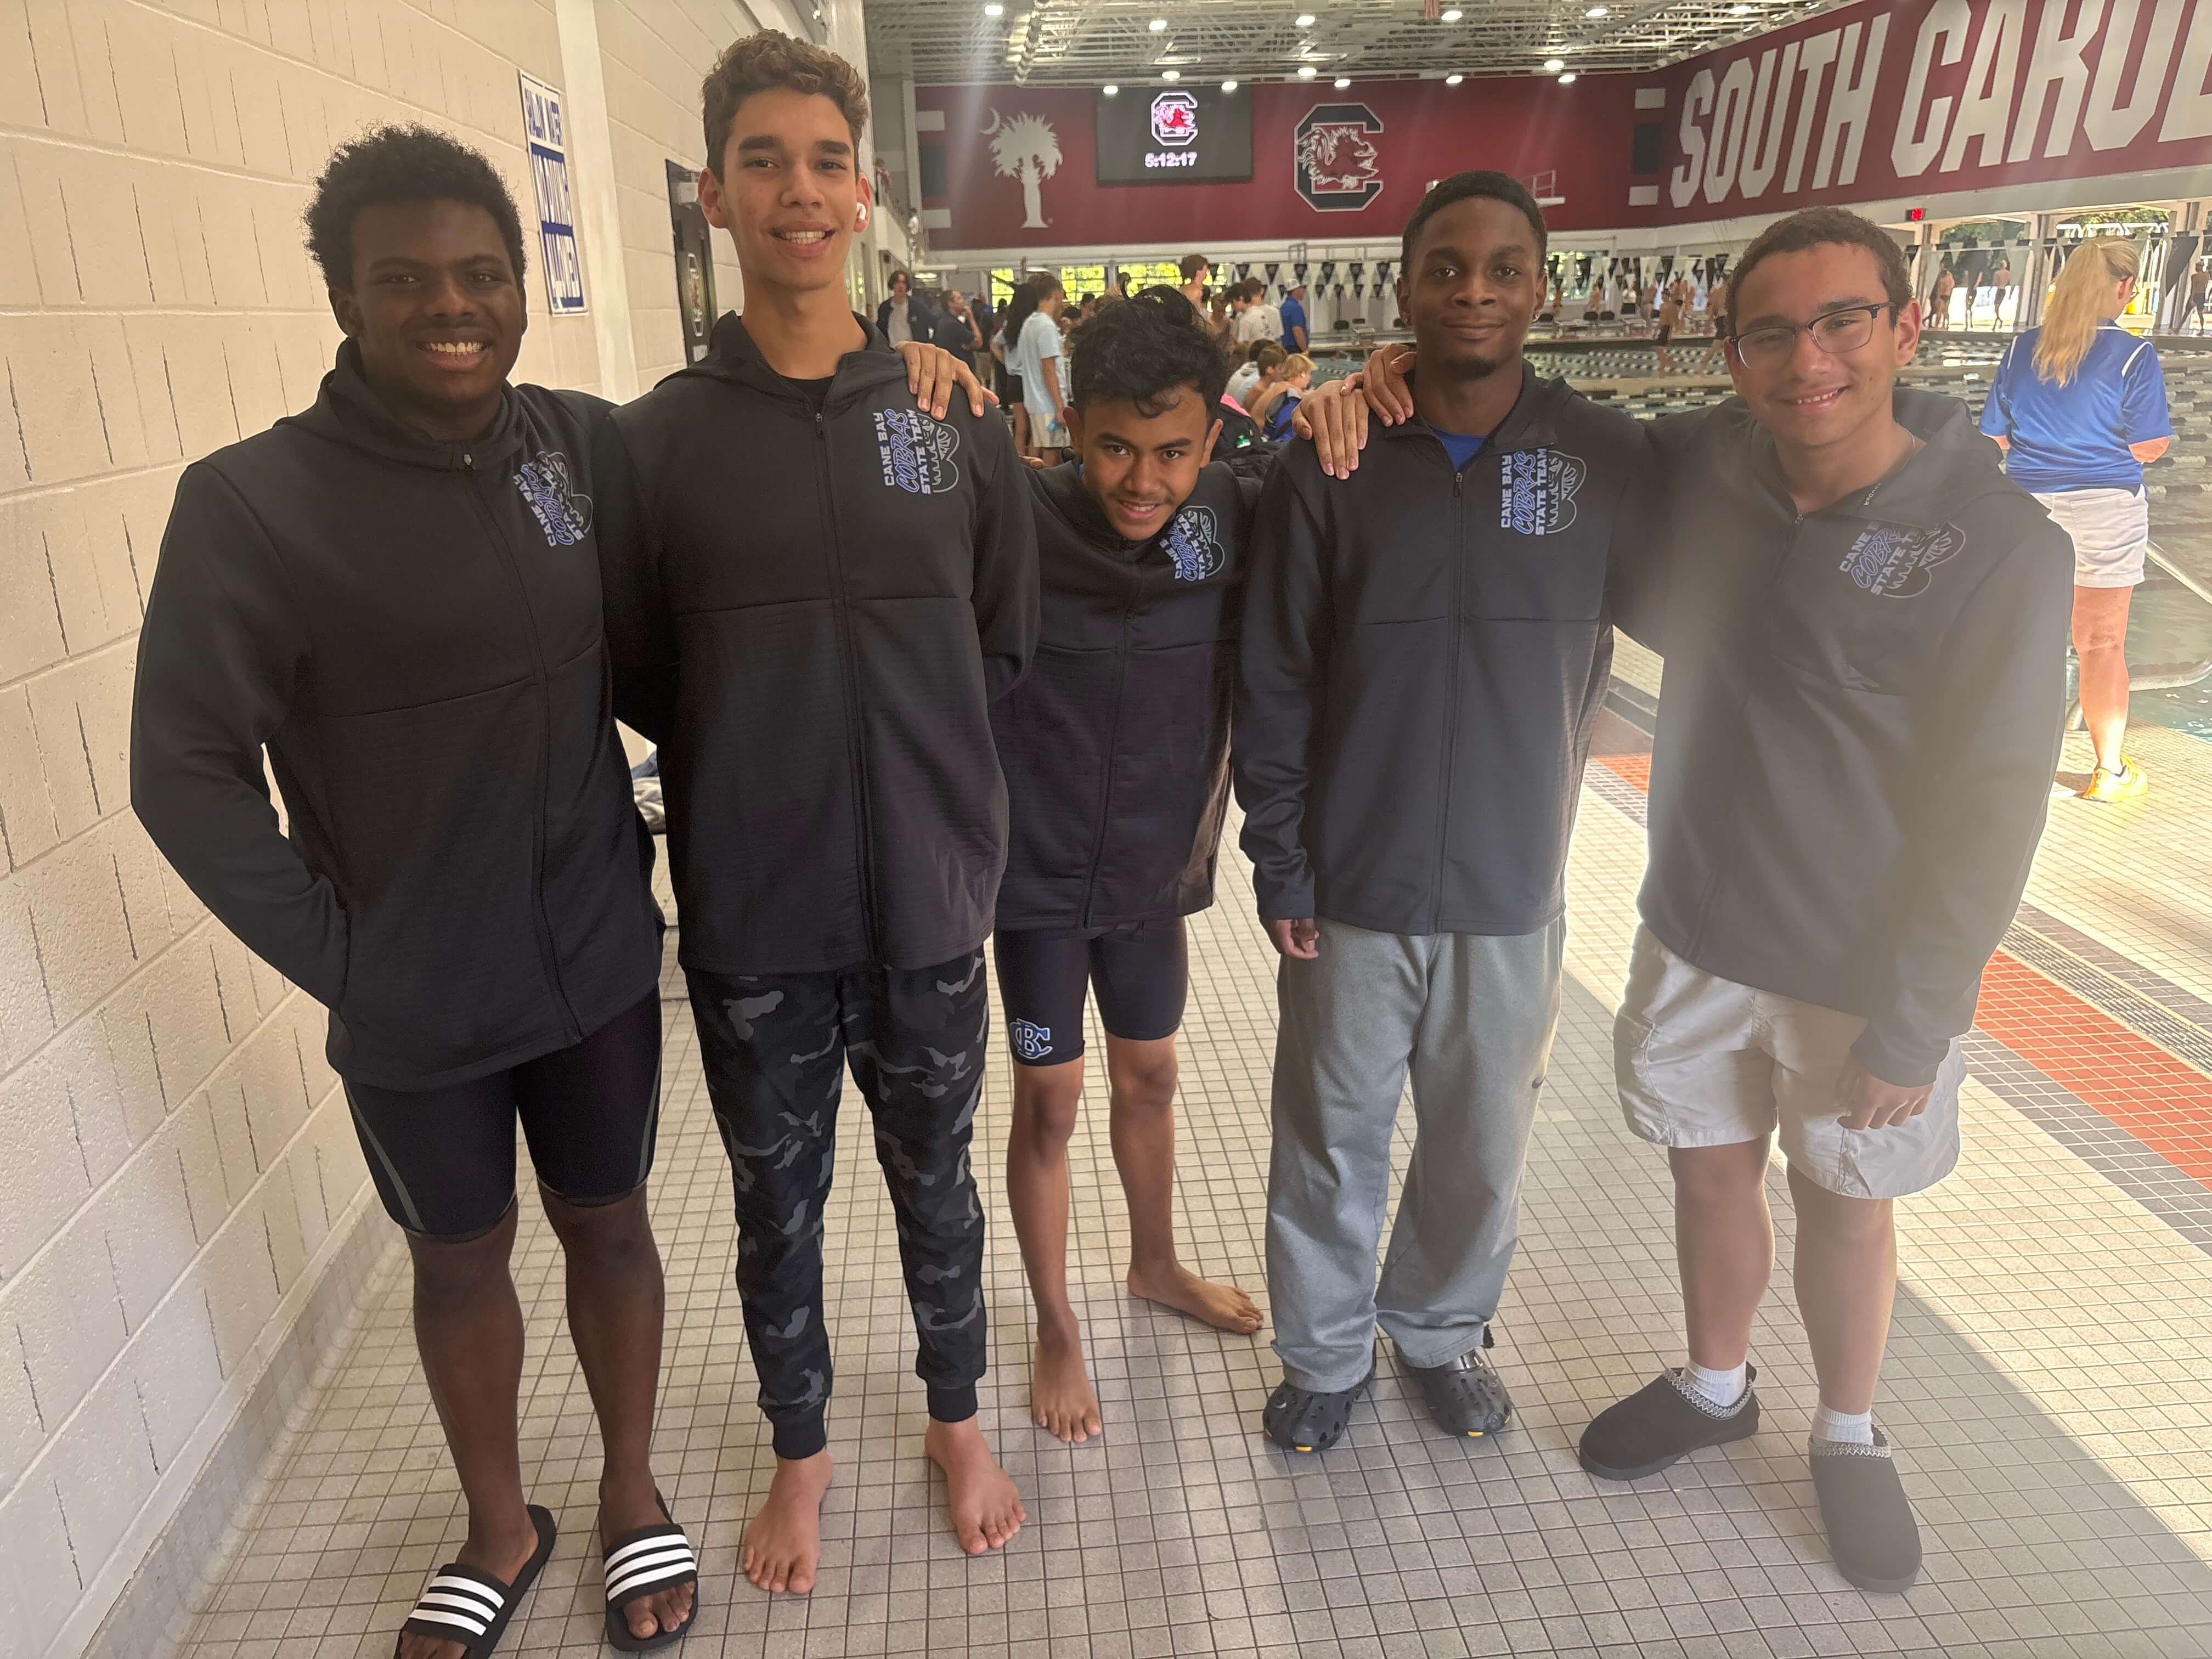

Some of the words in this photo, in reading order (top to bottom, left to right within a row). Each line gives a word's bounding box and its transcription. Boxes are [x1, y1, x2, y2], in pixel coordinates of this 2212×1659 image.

[1669, 12, 1891, 209] SOUTH
[1145, 151, 1197, 167] 5:12:17
[873, 412, 889, 442] BAY
[906, 409, 923, 442] TEAM
[879, 445, 895, 486] CANE
[884, 408, 919, 493] COBRAS
[915, 446, 932, 495] STATE
[1502, 455, 1512, 485] BAY
[1537, 448, 1547, 486] TEAM
[1501, 488, 1512, 528] CANE
[1513, 450, 1537, 534] COBRAS
[1536, 489, 1547, 536] STATE
[531, 505, 556, 547] CANE
[1176, 514, 1193, 538] TEA
[1165, 547, 1182, 580] CANE
[1190, 539, 1206, 580] STATE
[1839, 532, 1871, 573] CANE
[1871, 546, 1906, 595] STATE
